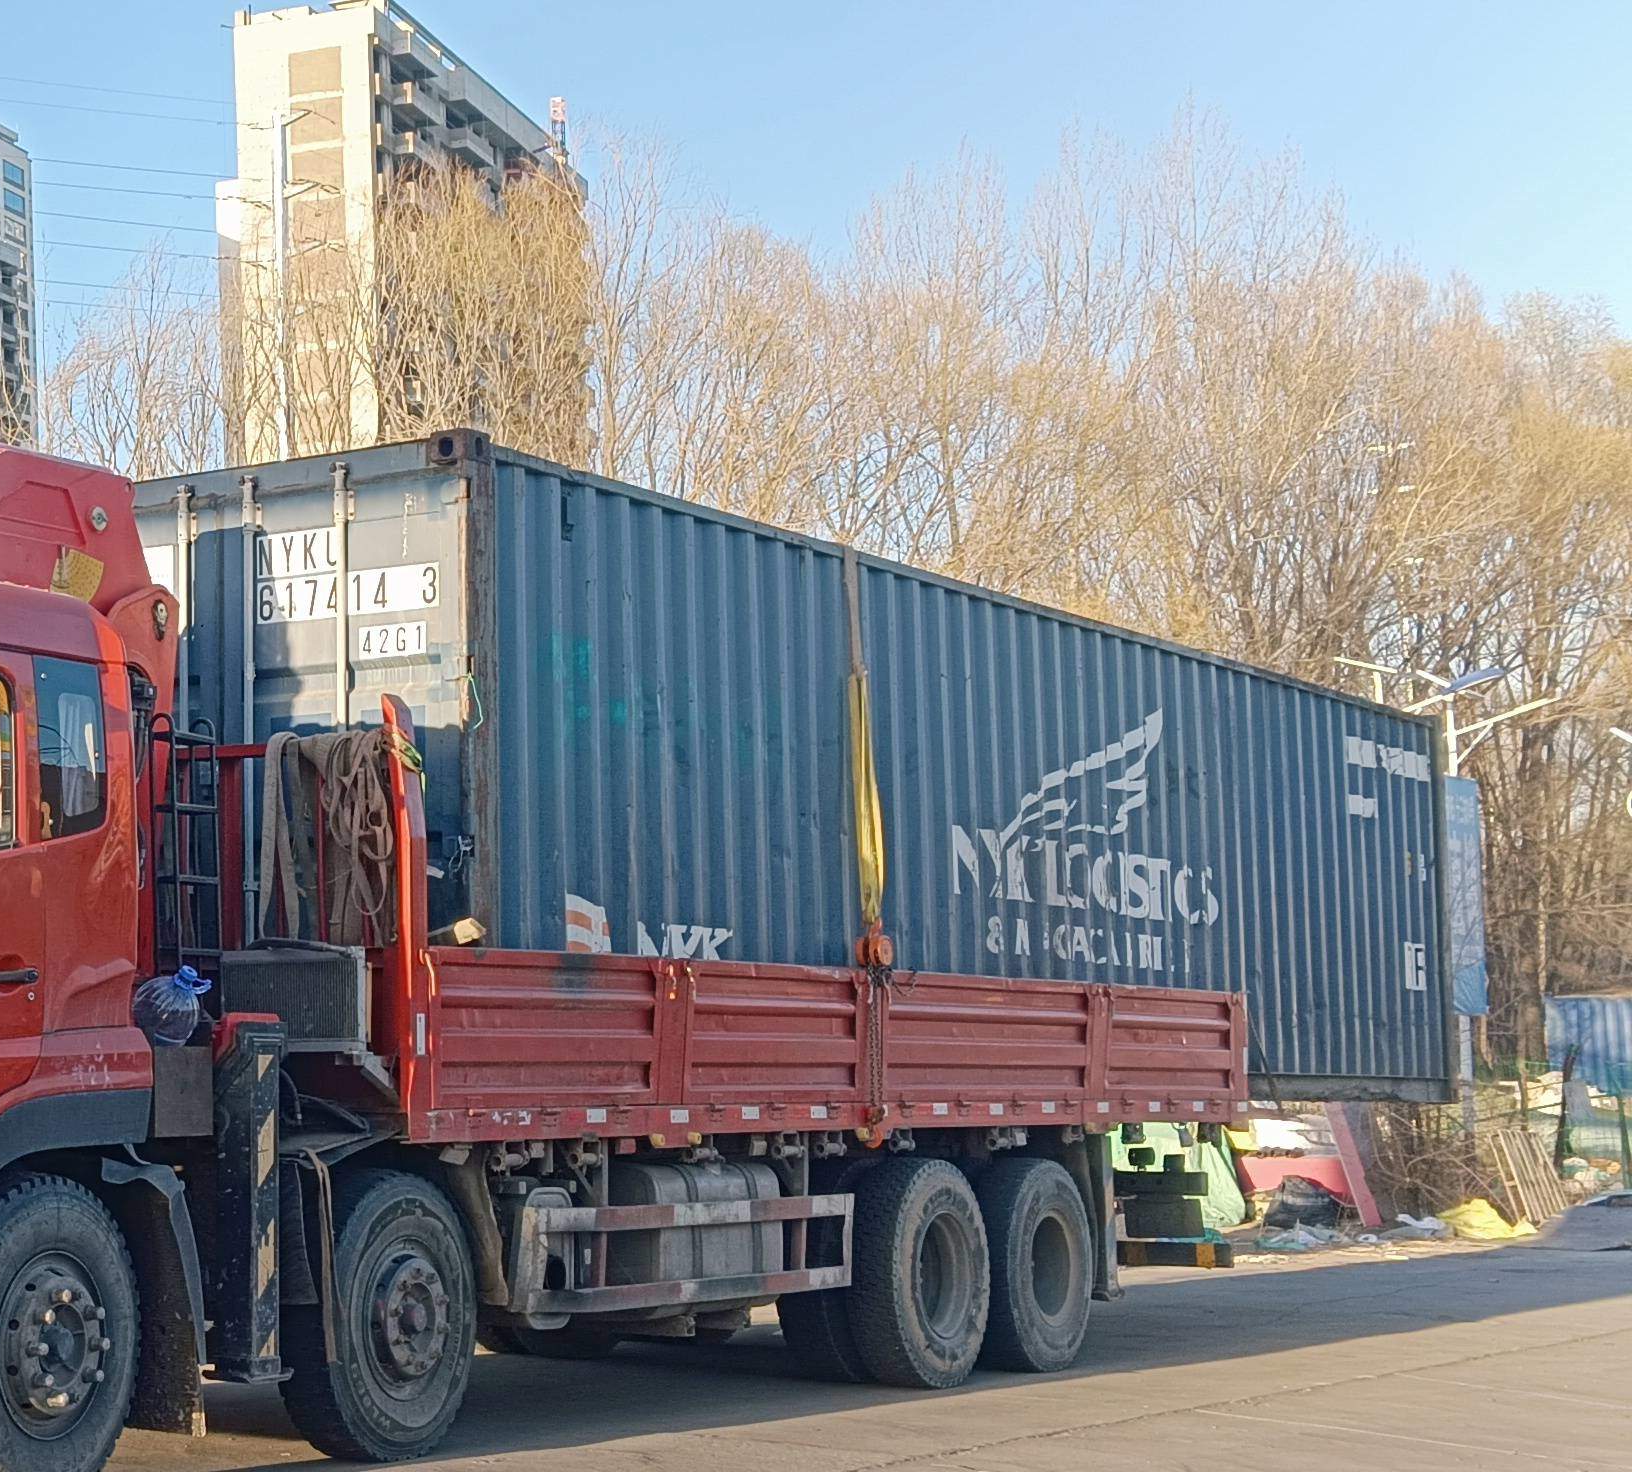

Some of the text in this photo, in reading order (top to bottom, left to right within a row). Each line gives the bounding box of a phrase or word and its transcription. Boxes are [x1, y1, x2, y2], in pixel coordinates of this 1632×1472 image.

[259, 566, 438, 622] 617414 3
[362, 624, 422, 655] 42G1
